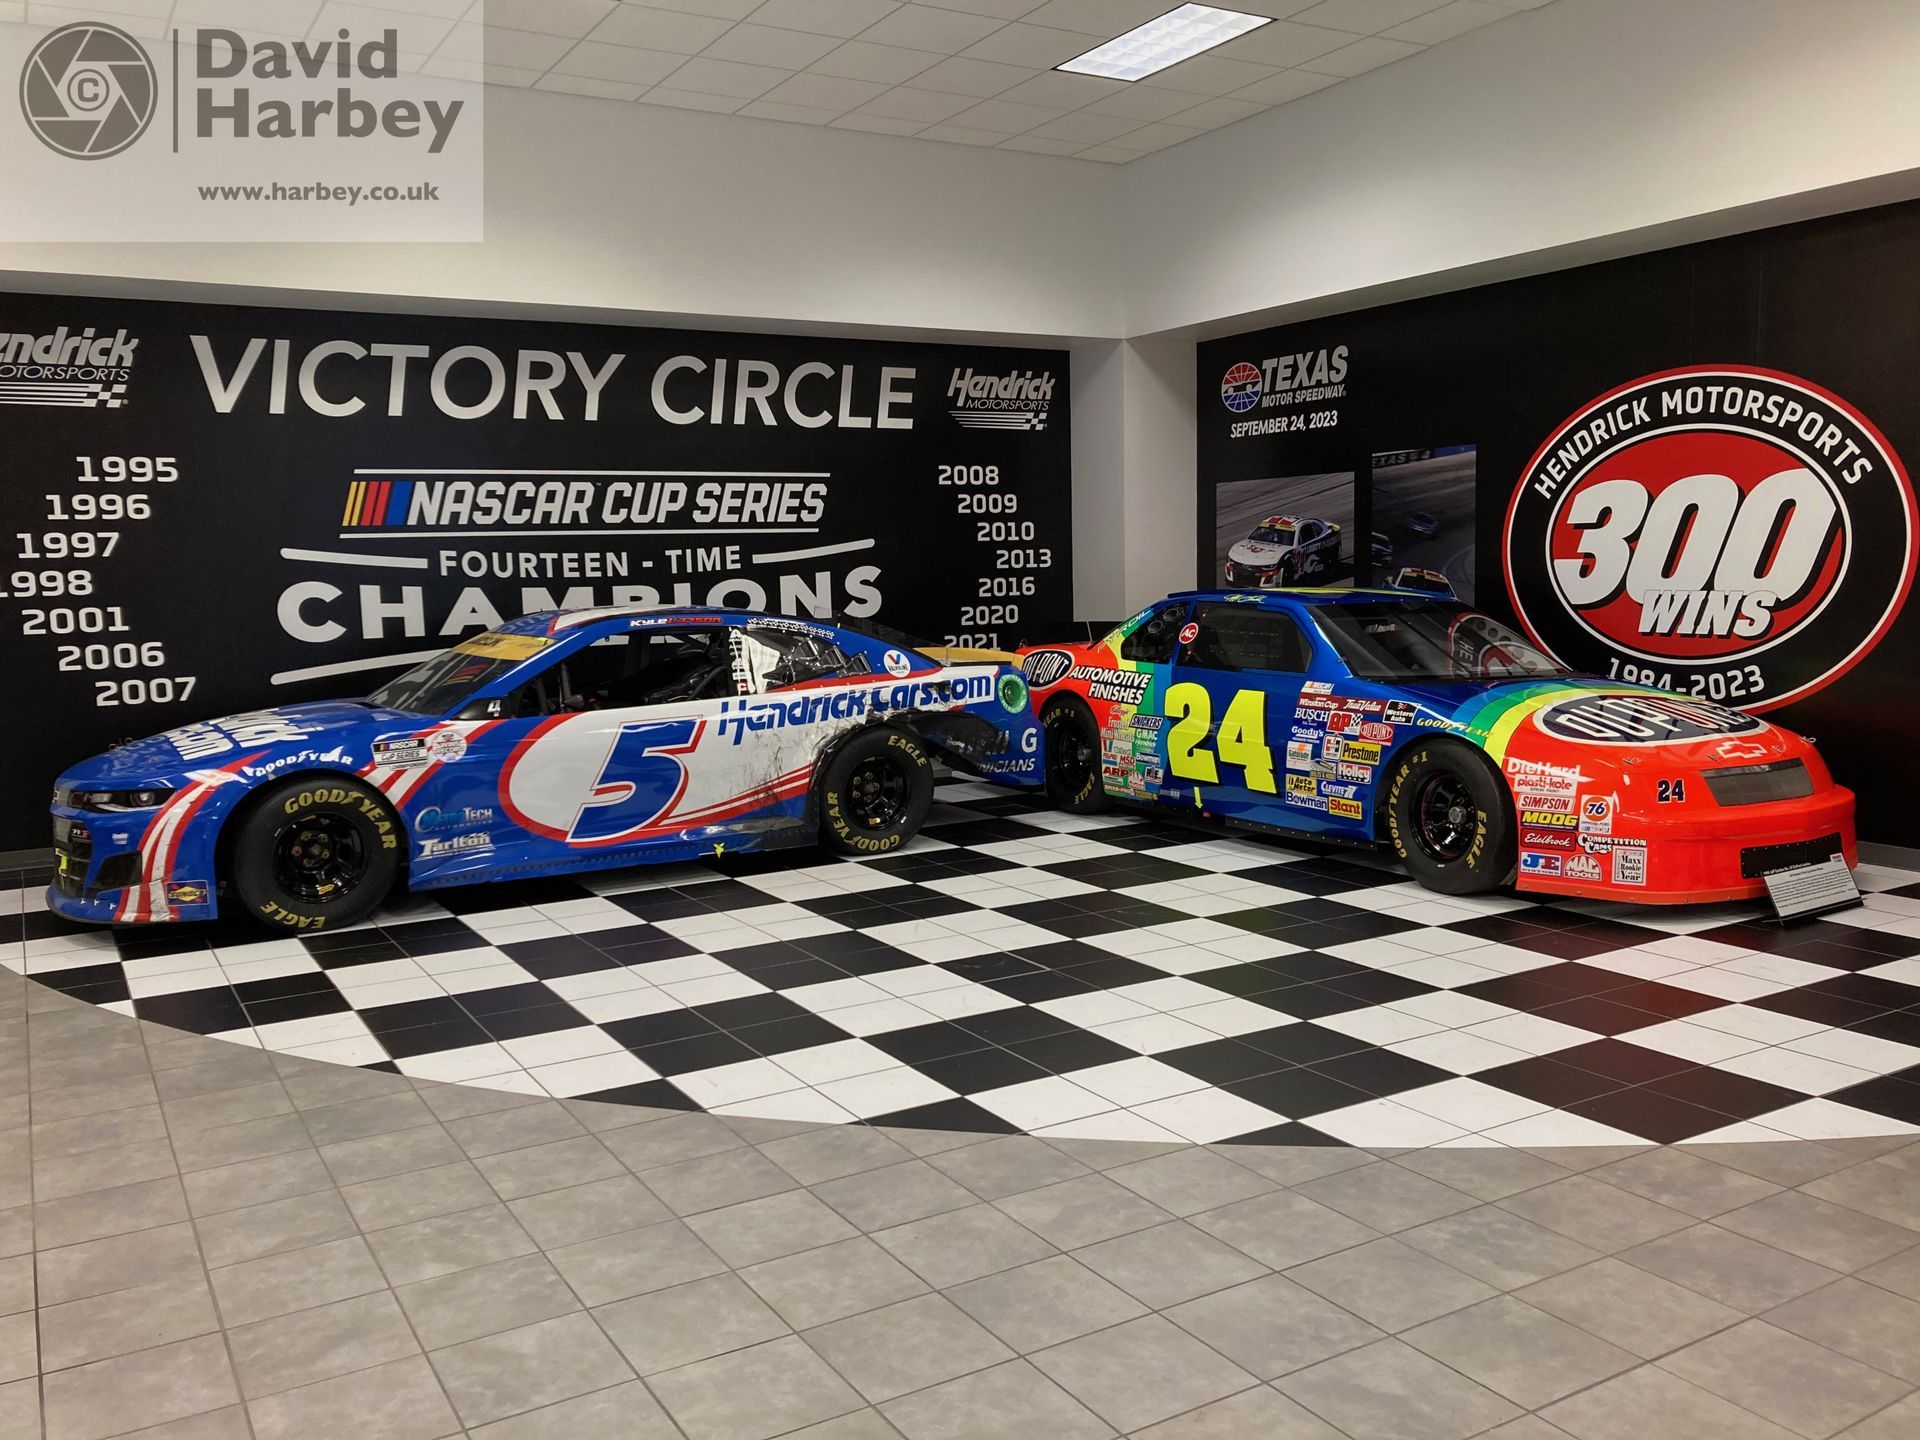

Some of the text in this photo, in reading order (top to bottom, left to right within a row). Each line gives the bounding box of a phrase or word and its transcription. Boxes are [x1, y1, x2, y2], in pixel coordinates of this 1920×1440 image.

[0, 364, 130, 381] OTORSPORTS
[1261, 345, 1349, 394] TEXAS
[190, 335, 917, 430] VICTORY CIRCLE
[947, 367, 1056, 407] Hendrick
[965, 398, 1050, 411] MOTORSPORTS
[1261, 384, 1344, 408] MOTOR SPEEDWAY
[1230, 410, 1338, 438] SEPTEMBER 24, 2023
[1534, 386, 1874, 500] HENDRICK MOTORSPORTS
[76, 456, 179, 483] 1995
[1372, 453, 1407, 468] EXAS
[938, 465, 999, 485] 2008
[45, 494, 152, 520] 1996
[407, 481, 828, 526] NASCAR CUP SERIES
[957, 494, 1017, 514] 2009
[977, 521, 1035, 541] 2010
[1553, 467, 1837, 605] 300
[16, 532, 120, 559] 1997
[439, 550, 629, 578] FOURTEEN
[665, 546, 742, 574] TIME
[996, 549, 1052, 569] 2013
[978, 576, 1036, 597] 2016
[21, 606, 130, 635] 2001
[960, 604, 1019, 626] 2020
[1638, 589, 1778, 639] WINS
[944, 633, 1001, 650] 2021
[1181, 628, 1196, 639] AC
[57, 641, 165, 671] 2006
[1068, 666, 1152, 688] AUTOMOTIVE
[95, 676, 197, 707] 2007
[1088, 683, 1145, 705] FINISHES
[1299, 698, 1325, 709] Winston
[1324, 700, 1339, 711] Cup
[1386, 709, 1414, 718] Western
[1131, 715, 1162, 729] SNICKERS
[1294, 708, 1329, 721] BUSCH
[1328, 712, 1353, 731] AP
[1136, 729, 1158, 740] GMAC
[1291, 726, 1324, 738] Goody's
[1417, 718, 1493, 738] GOODYEAR
[1164, 682, 1277, 794] 24
[887, 735, 928, 767] EAGLE
[1288, 750, 1310, 759] Gatorade
[1342, 743, 1379, 762] Prestone
[567, 714, 708, 848] 5
[1103, 766, 1129, 777] ARP
[1295, 777, 1312, 785] Auto
[1339, 763, 1370, 782] Holley
[1293, 784, 1316, 793] Meter
[1321, 781, 1345, 795] CLEVITE
[1517, 776, 1573, 791] plasti-kote
[1657, 779, 1686, 803] 24
[1286, 792, 1328, 809] Bowman
[1330, 799, 1361, 815] Stant
[1521, 796, 1570, 810] SIMPSON
[1587, 802, 1606, 816] 76
[283, 789, 398, 849] GOODYEAR
[1388, 764, 1411, 859] GOODYEAR
[1522, 811, 1579, 826] MOOG
[827, 791, 901, 852] GOODYEAR
[1466, 810, 1488, 869] EAGLE
[1524, 833, 1571, 847] Edelbrock
[1577, 833, 1647, 847] COMPETITION
[1585, 842, 1613, 854] CAMS
[1522, 853, 1560, 871] JE
[1567, 855, 1600, 873] MAC
[1621, 855, 1641, 865] Maxx
[1566, 872, 1601, 880] TOOLS
[1621, 870, 1641, 881] Year
[168, 889, 208, 899] SUNOCO
[261, 901, 326, 929] EAGLE
